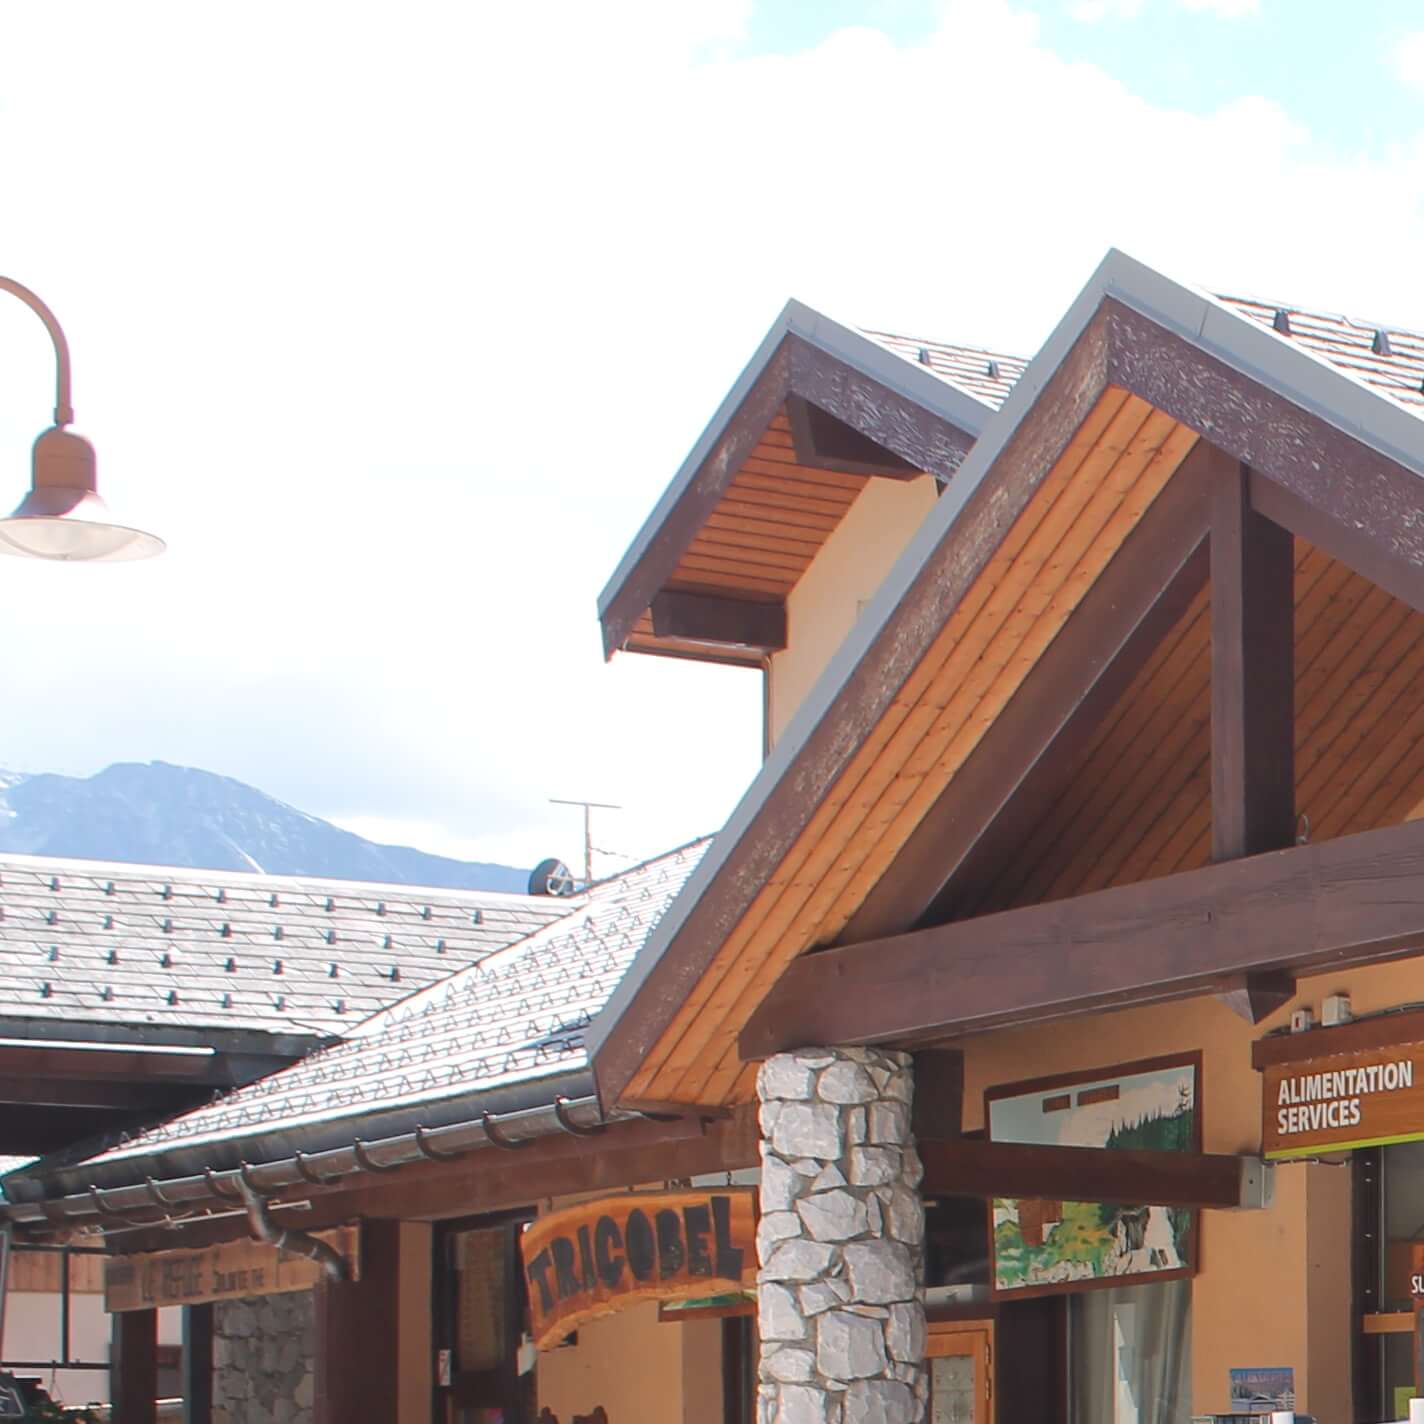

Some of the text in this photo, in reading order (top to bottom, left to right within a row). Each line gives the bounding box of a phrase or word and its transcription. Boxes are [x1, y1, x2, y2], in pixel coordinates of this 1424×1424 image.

[1278, 1060, 1413, 1106] ALIMENTATION
[1278, 1098, 1361, 1135] SERVICES
[527, 1196, 745, 1314] TRICOBEL
